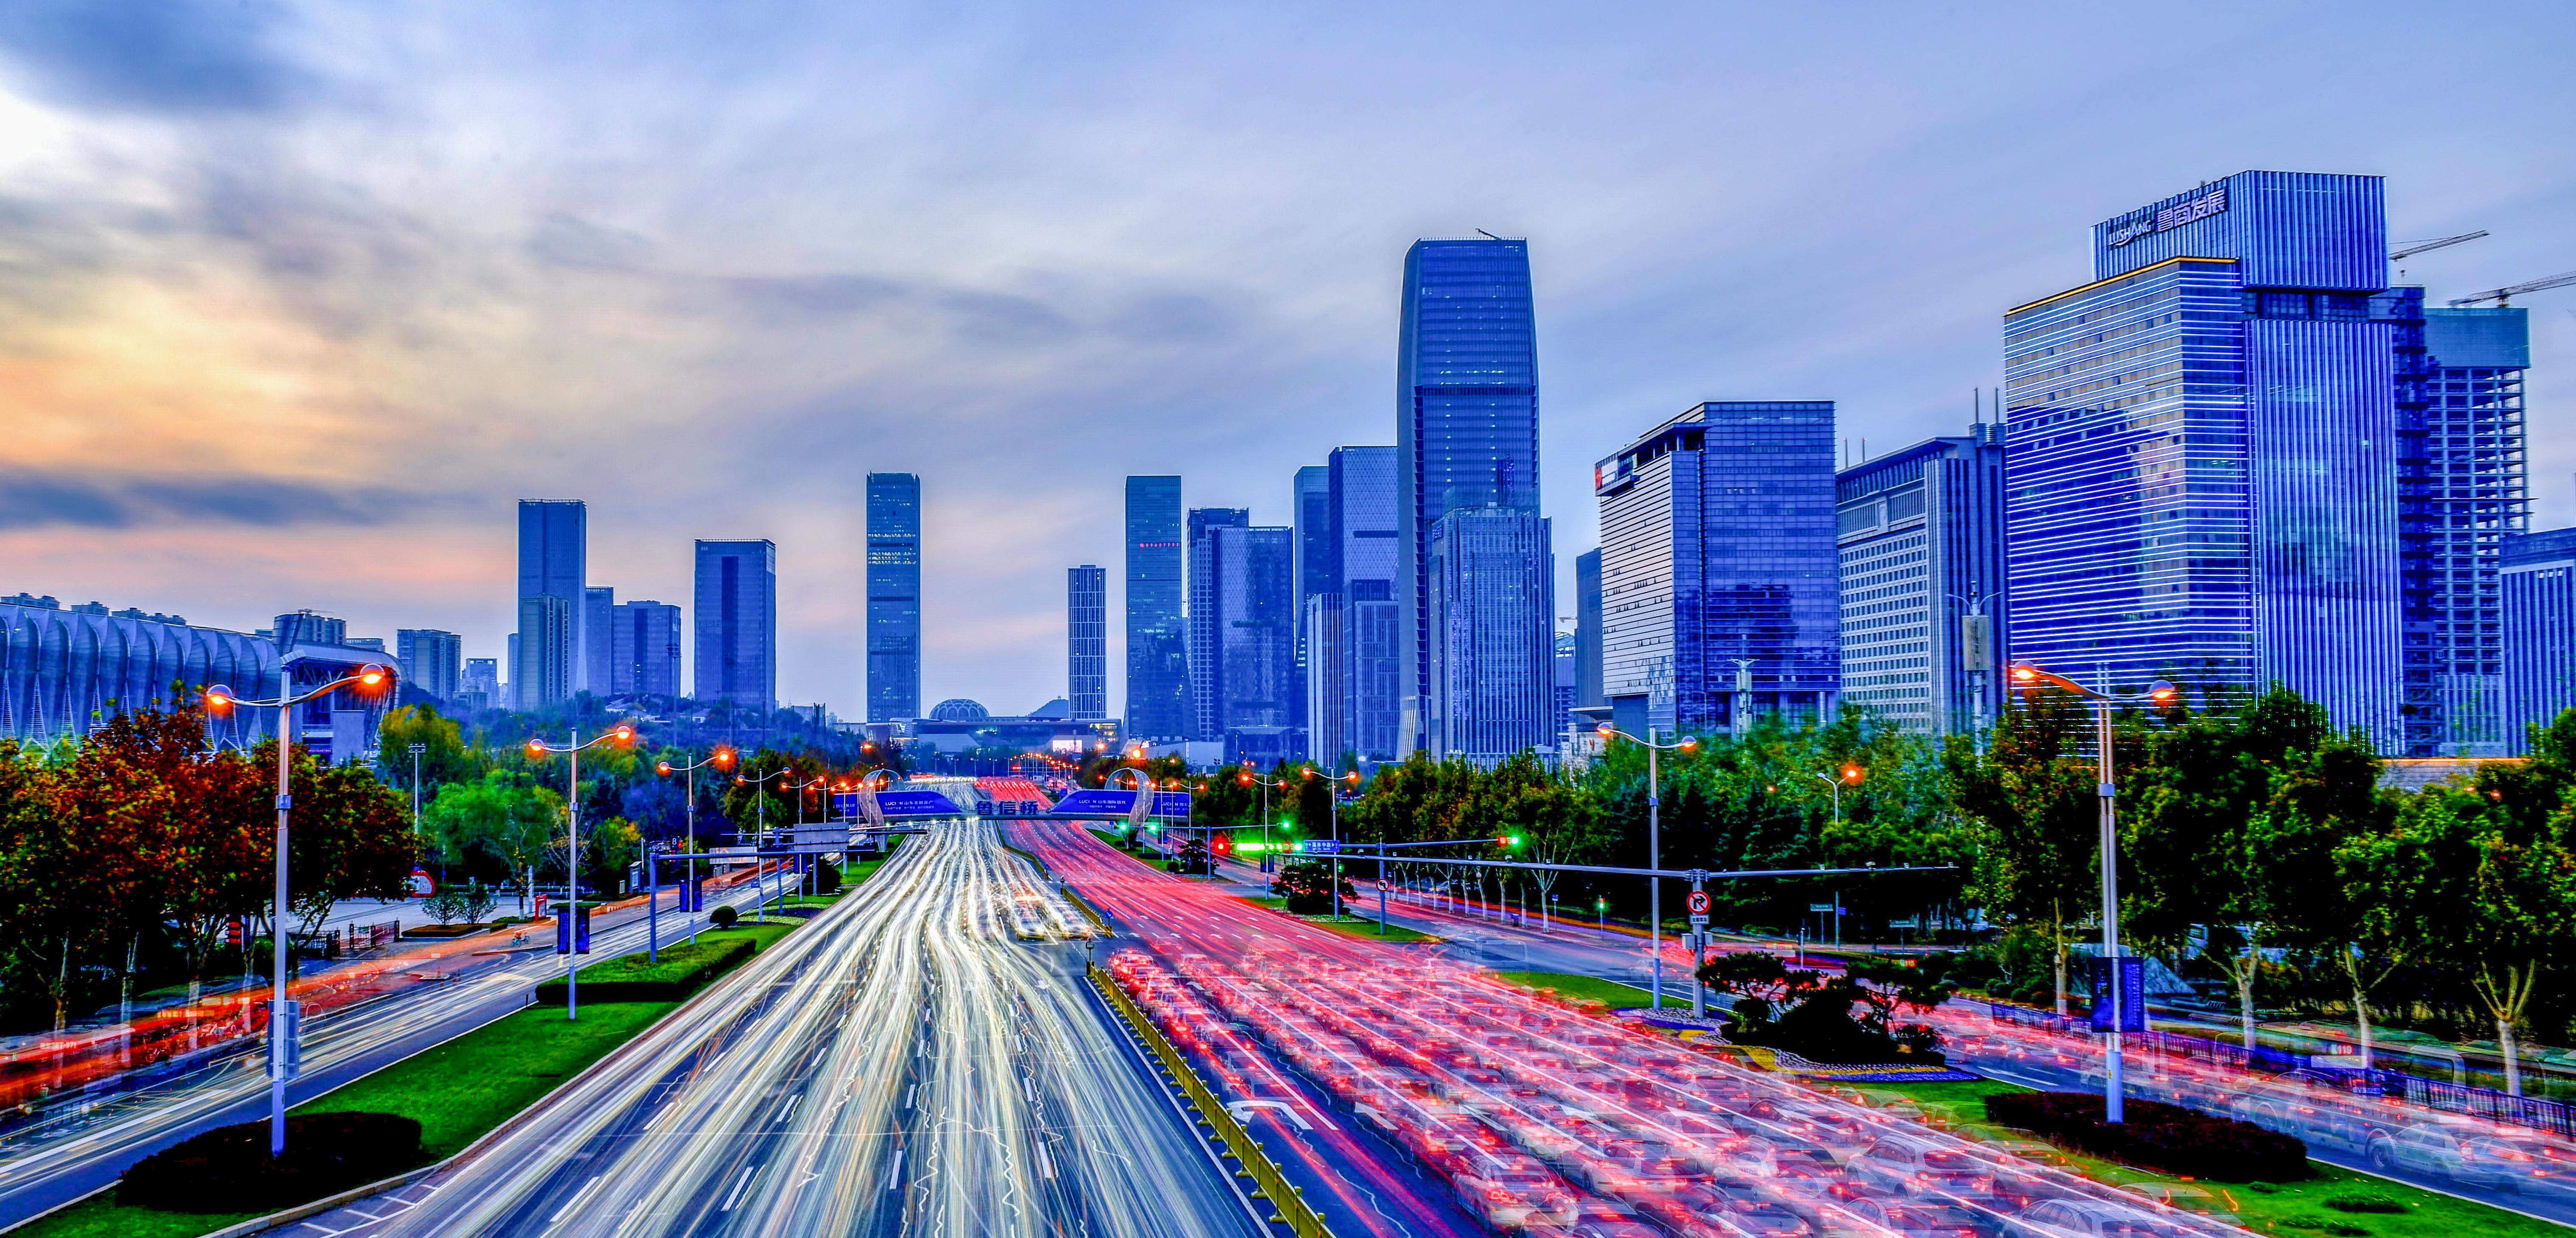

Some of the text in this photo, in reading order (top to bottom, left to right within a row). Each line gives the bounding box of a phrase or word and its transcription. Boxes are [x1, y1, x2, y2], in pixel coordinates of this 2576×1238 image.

[2109, 189, 2225, 246] LUSHANG 鲁商发展
[976, 800, 1038, 815] 鲁信桥
[2331, 1044, 2352, 1054] K119
